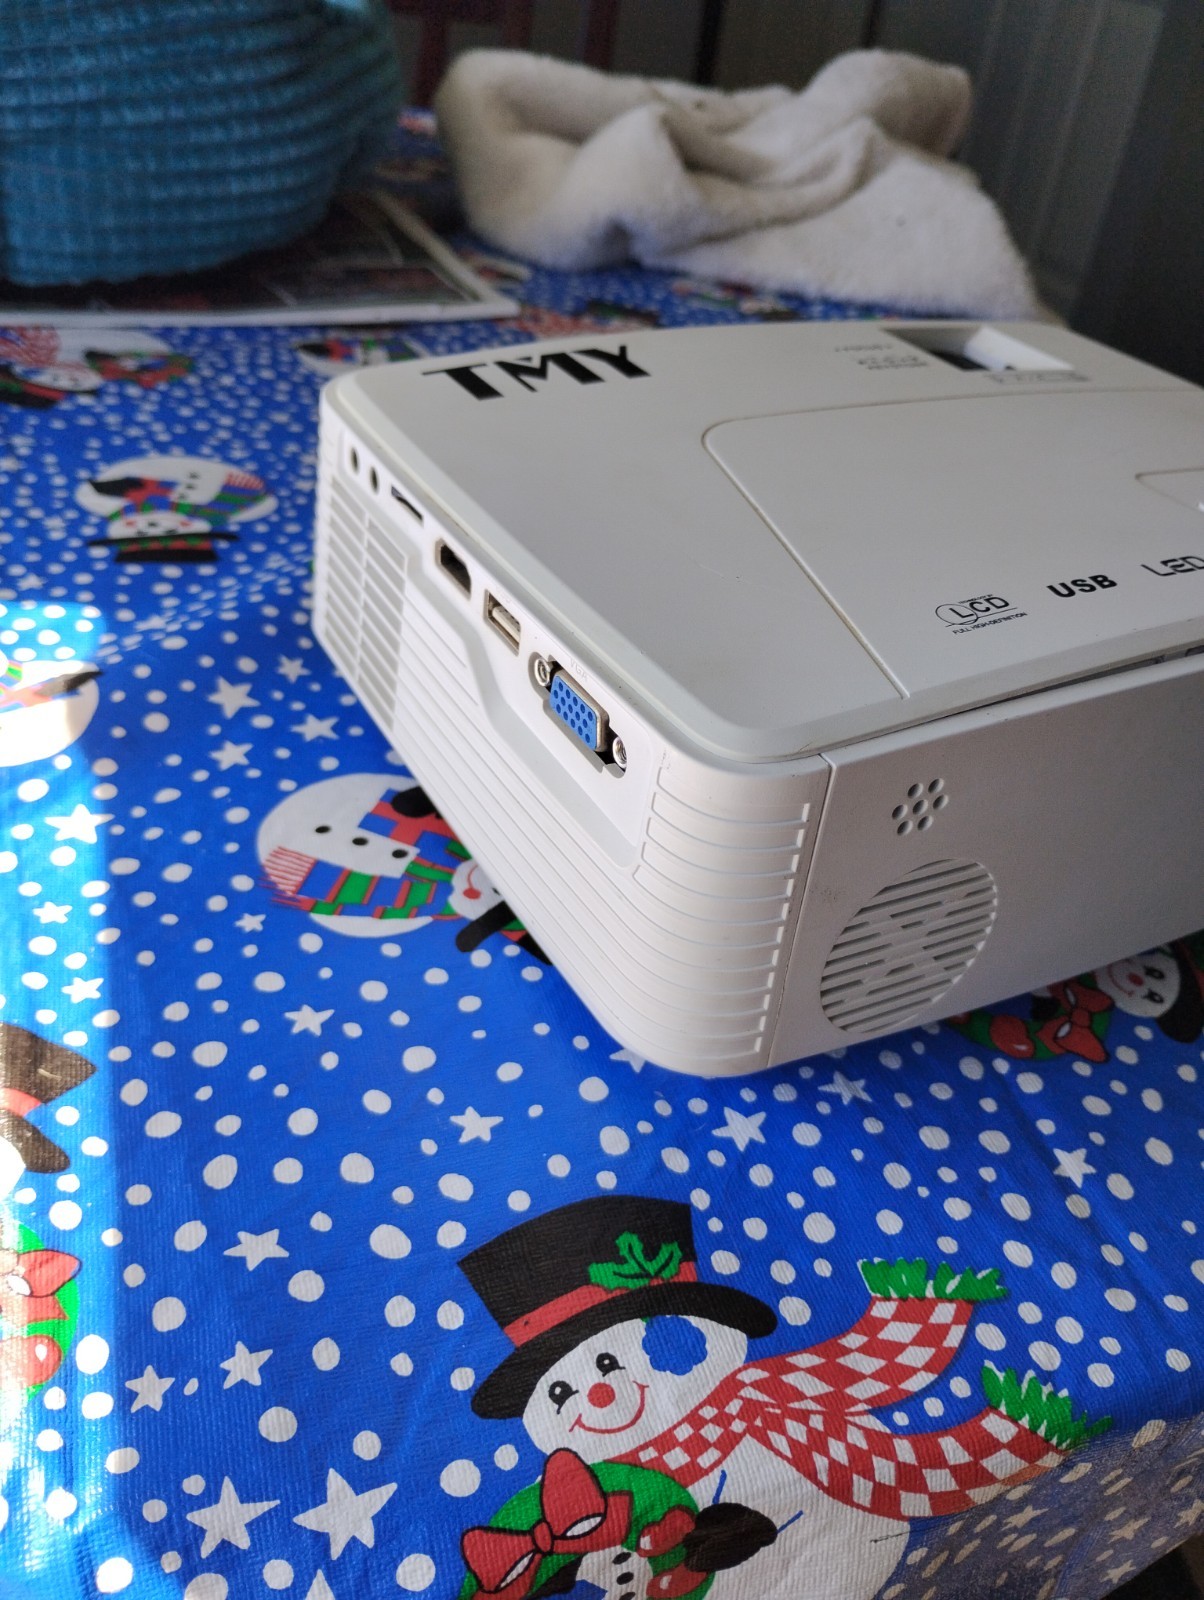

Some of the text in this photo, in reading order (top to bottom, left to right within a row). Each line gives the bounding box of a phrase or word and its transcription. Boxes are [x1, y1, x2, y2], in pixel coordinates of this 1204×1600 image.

[422, 345, 651, 401] TMY
[1140, 555, 1204, 577] LED
[1046, 574, 1118, 598] USB
[948, 596, 1010, 619] LCD
